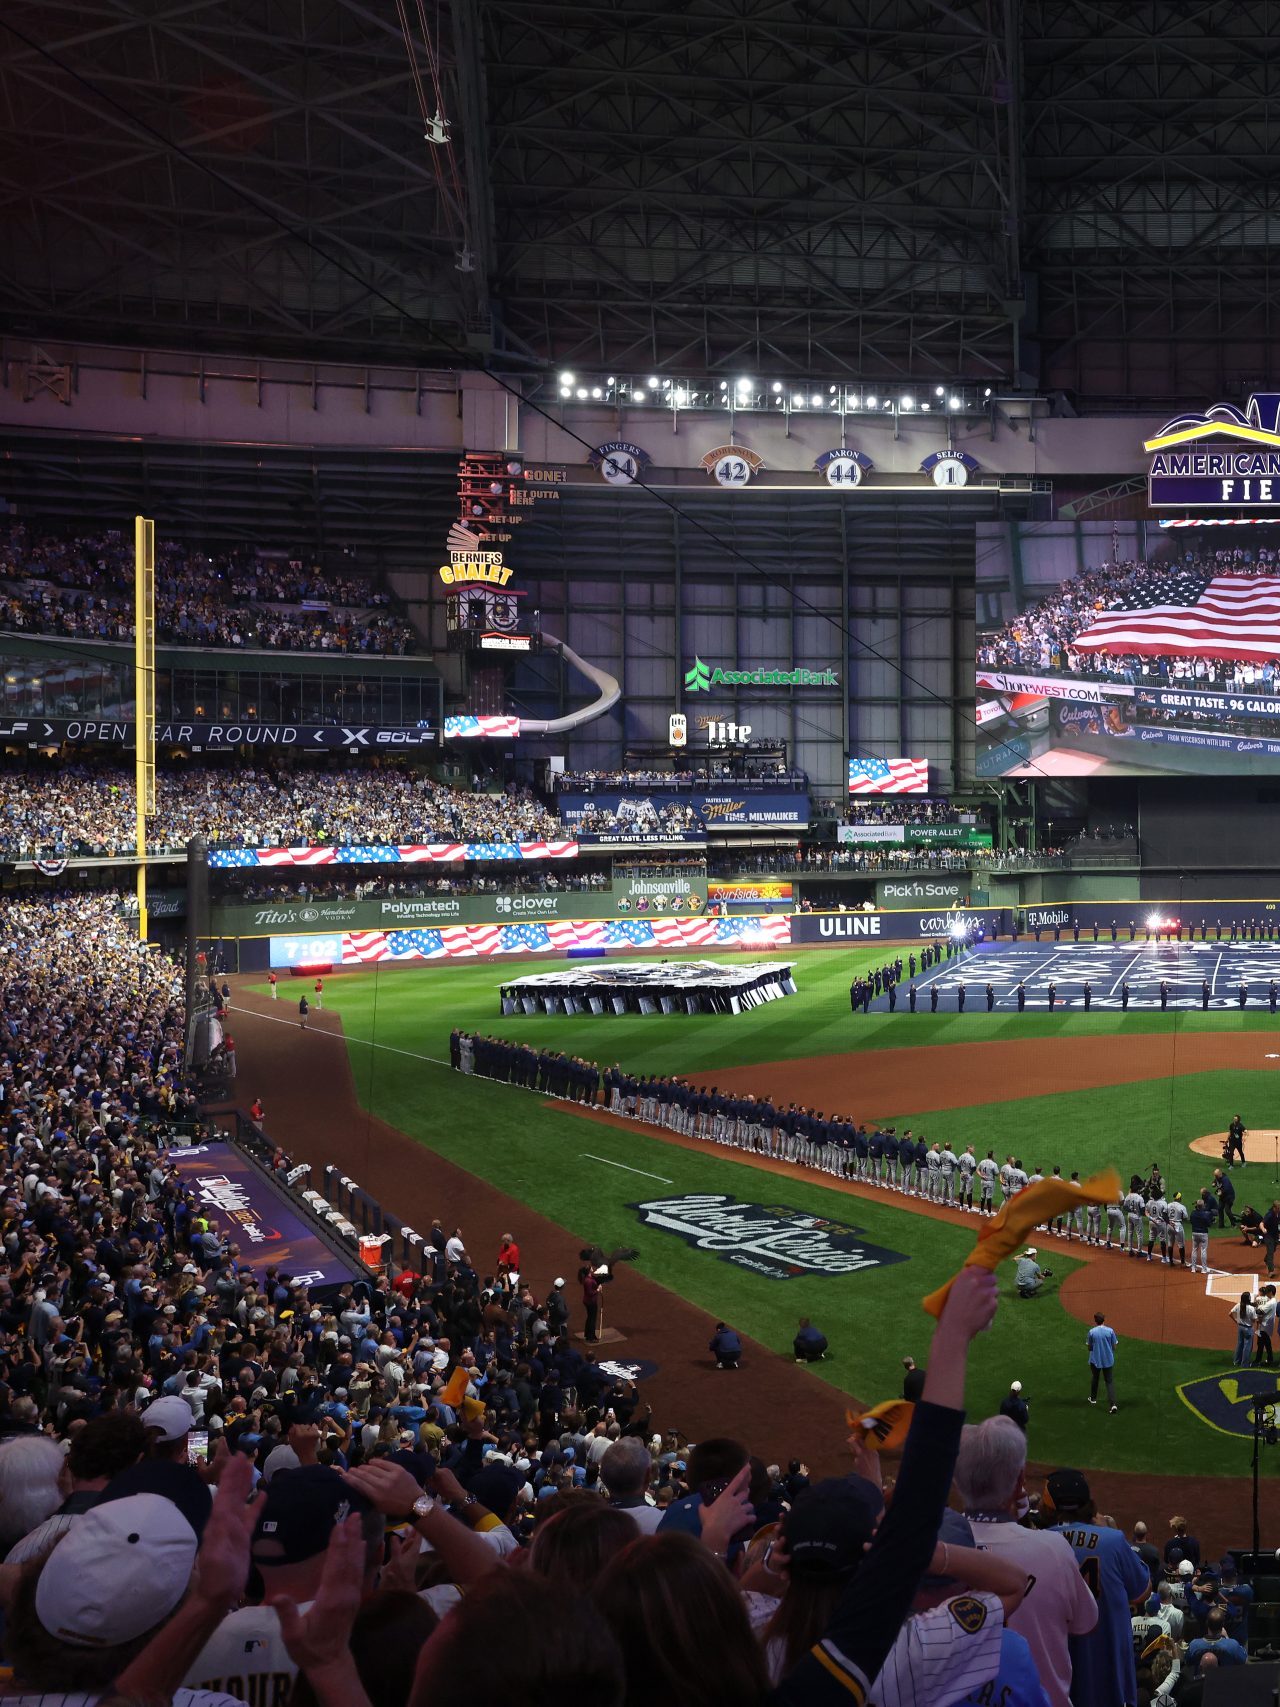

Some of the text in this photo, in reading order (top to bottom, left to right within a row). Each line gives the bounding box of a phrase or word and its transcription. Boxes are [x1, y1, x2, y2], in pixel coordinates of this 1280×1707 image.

[600, 443, 641, 455] FINGERS
[829, 449, 859, 459] AARON
[936, 450, 964, 460] SELIG
[606, 458, 635, 478] 34
[718, 462, 747, 482] 42
[830, 464, 858, 484] 44
[525, 470, 567, 482] GONE!
[945, 466, 957, 485] 1
[510, 497, 535, 506] HERE
[530, 490, 560, 499] OUTTA
[489, 515, 523, 524] GET UP
[479, 533, 512, 542] GET UP
[451, 551, 503, 564] BERNIE'S
[439, 563, 514, 586] CHALET
[1161, 694, 1192, 706] GREAT
[1194, 697, 1228, 710] TASTE.
[1230, 700, 1245, 711] 96
[66, 722, 127, 740] OPEN
[148, 725, 194, 742] EAR
[208, 727, 297, 743] ROUND
[376, 732, 435, 743] GOLF
[1167, 734, 1180, 743] FROM
[1180, 735, 1206, 745] WISCONSIN
[1206, 738, 1219, 747] WITH
[584, 803, 595, 811] GO
[701, 801, 746, 821] Miller
[749, 812, 799, 821] MILWAUKEE
[910, 828, 963, 837] POWER ALLEY
[629, 879, 691, 895] Johnsonville
[714, 887, 759, 901] Surfside
[884, 884, 959, 897] Pick Save
[382, 900, 460, 914] Polymatech
[513, 896, 558, 910] clover
[255, 909, 297, 925] Tito's
[321, 906, 356, 917] Handmade
[819, 916, 880, 936] ULINE
[284, 941, 338, 959] 7:02
[638, 1195, 781, 1240] World
